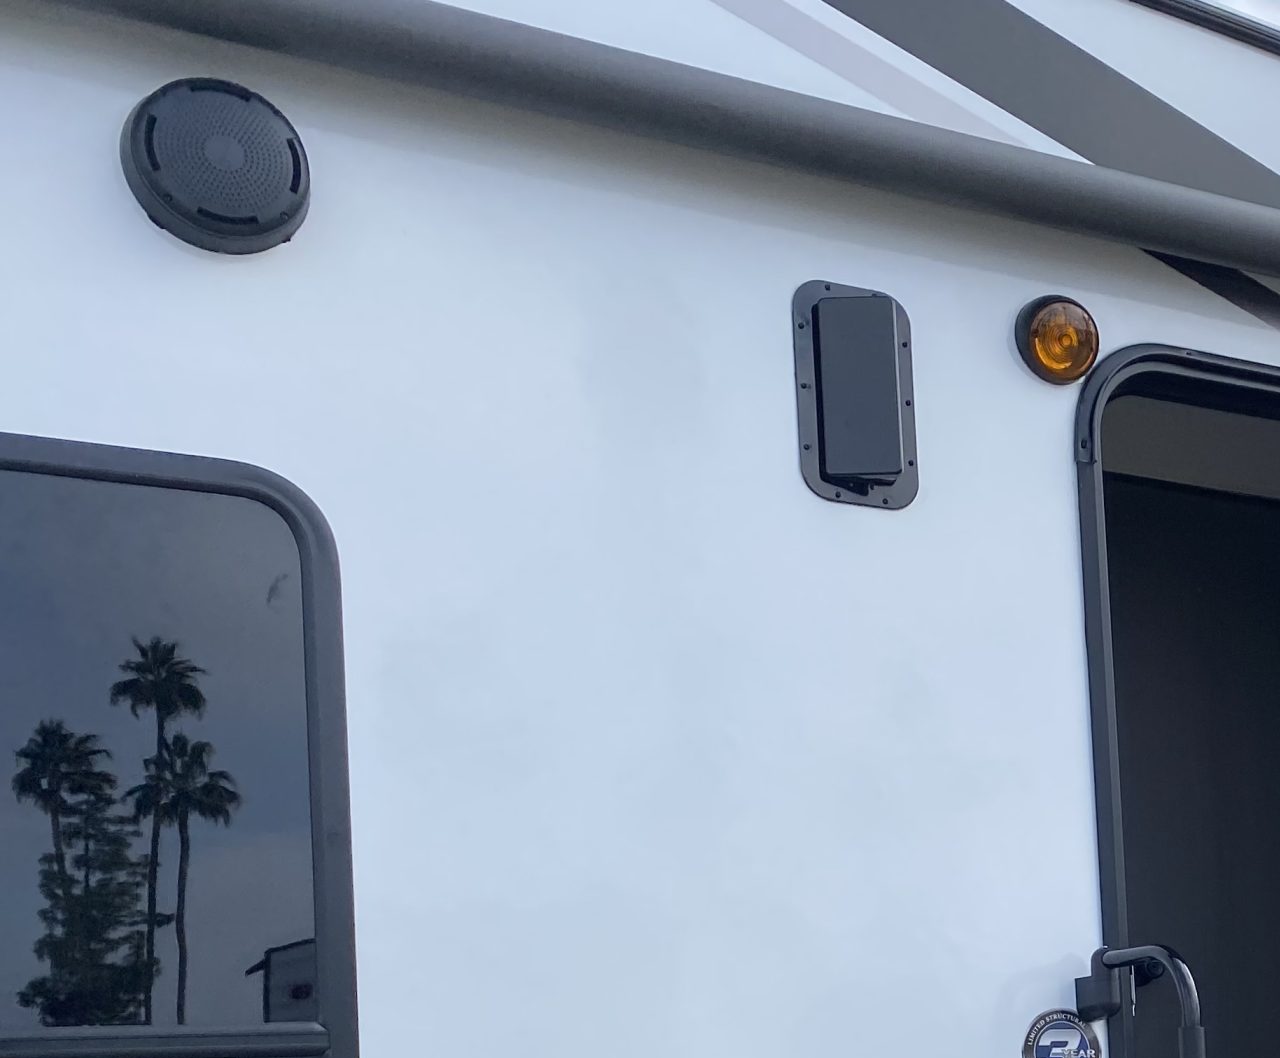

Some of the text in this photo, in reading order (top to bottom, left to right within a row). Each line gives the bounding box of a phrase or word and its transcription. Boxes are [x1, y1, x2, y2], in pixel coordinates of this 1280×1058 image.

[1027, 1013, 1087, 1046] LIMITED STRUCTURAL
[1061, 1048, 1096, 1058] YEAR
